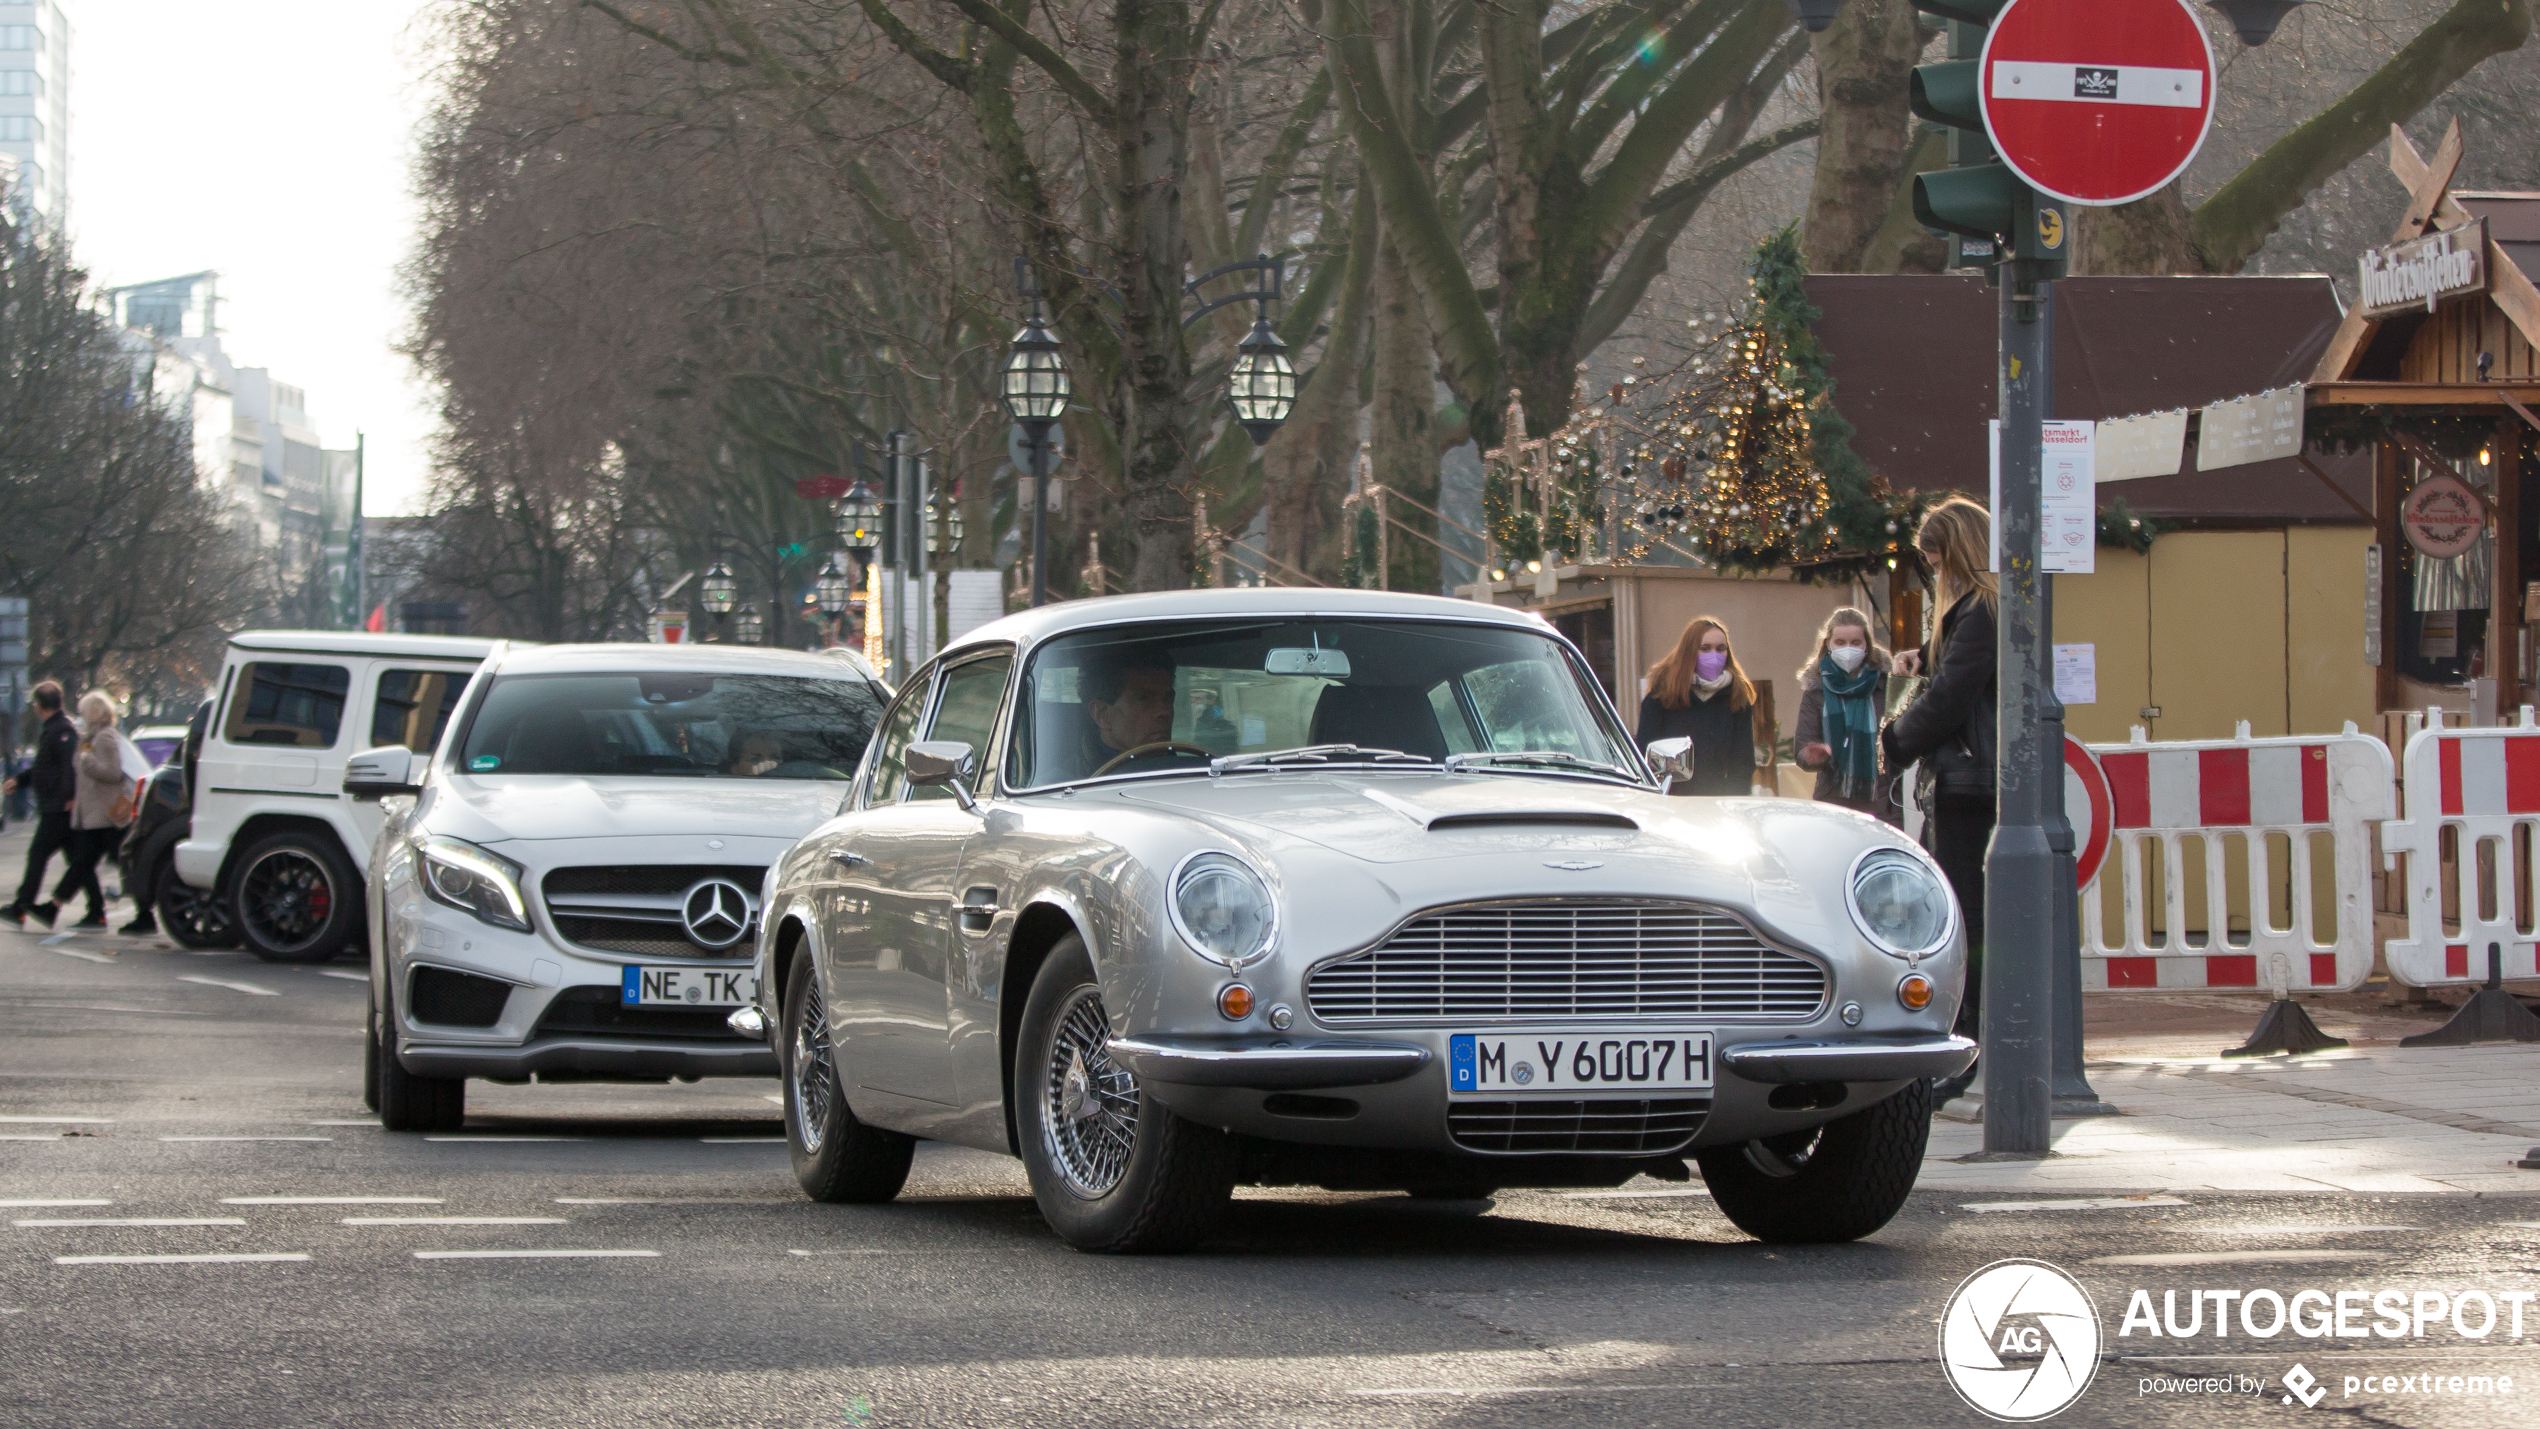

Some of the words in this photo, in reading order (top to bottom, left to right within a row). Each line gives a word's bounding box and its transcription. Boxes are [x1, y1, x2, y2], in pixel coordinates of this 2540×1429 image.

[643, 971, 681, 1000] NE
[704, 973, 741, 1002] TK
[1459, 1069, 1470, 1081] D
[1480, 1041, 1506, 1083] M
